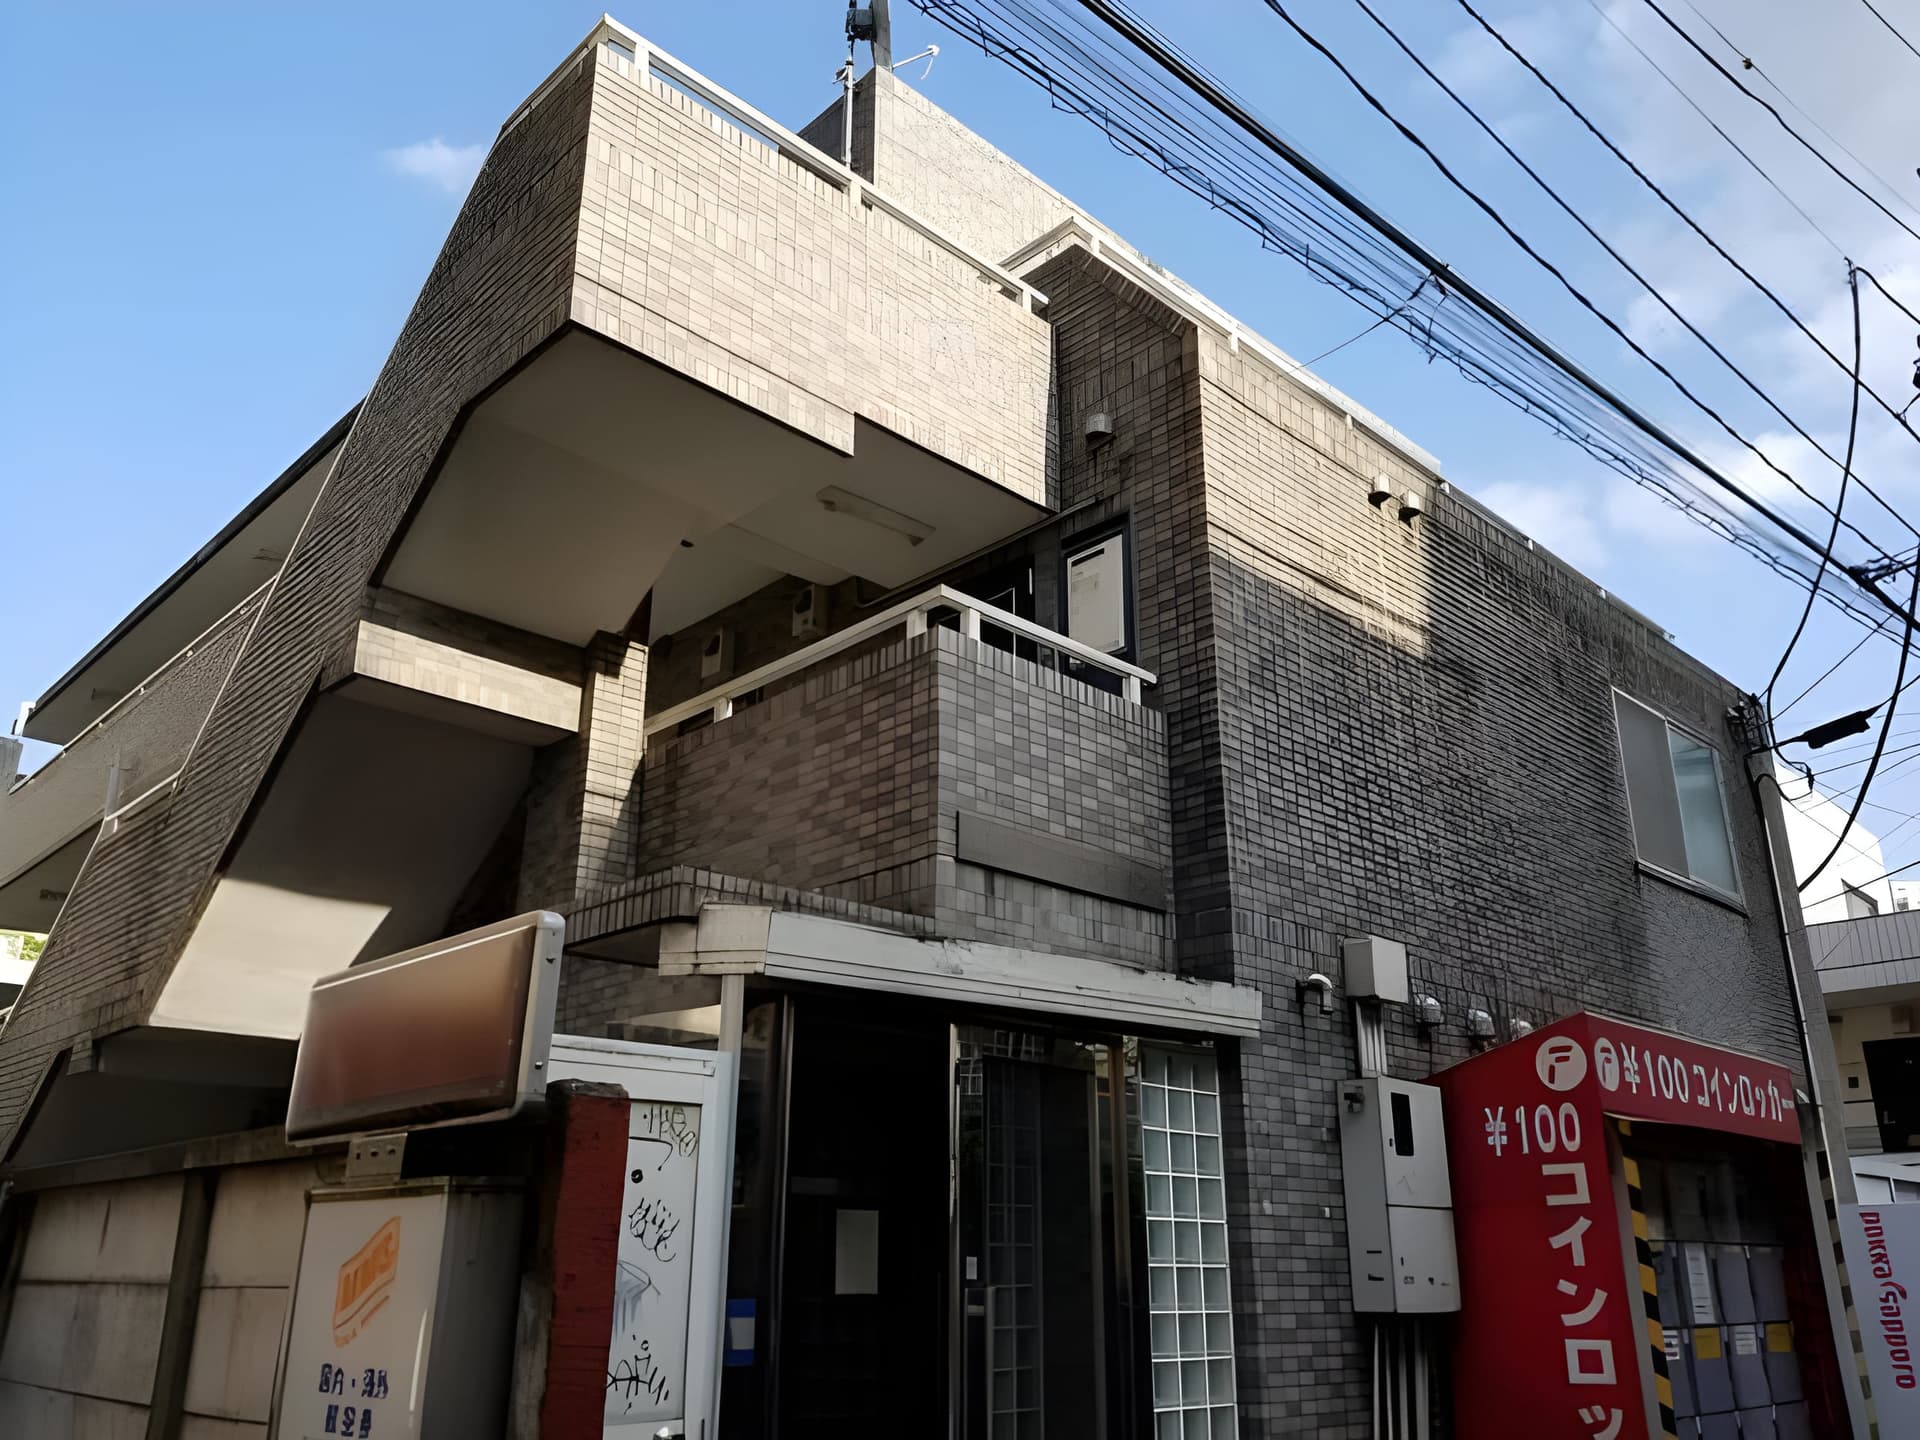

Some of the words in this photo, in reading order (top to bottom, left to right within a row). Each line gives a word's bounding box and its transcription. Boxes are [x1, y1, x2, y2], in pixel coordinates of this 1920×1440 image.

[1620, 1041, 1689, 1103] ¥100
[1693, 1064, 1795, 1122] コインロッカー
[1484, 1102, 1581, 1157] ¥100
